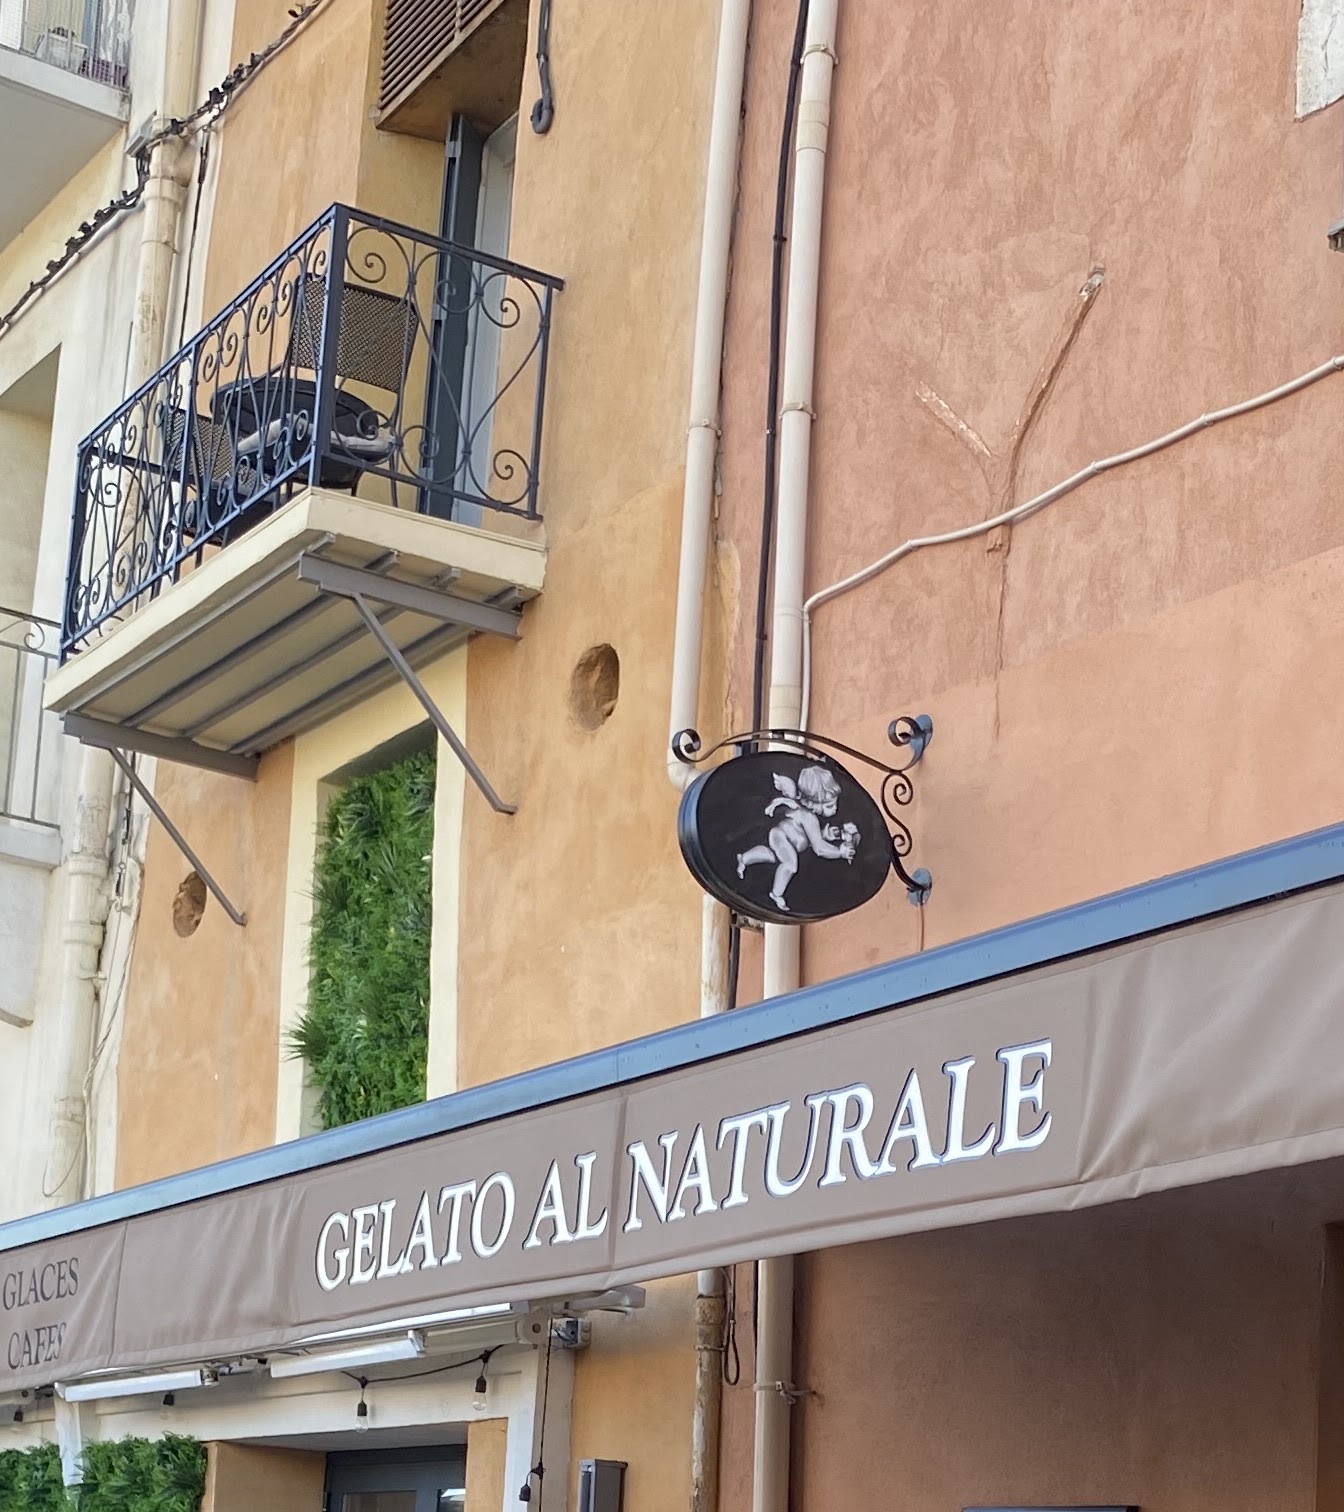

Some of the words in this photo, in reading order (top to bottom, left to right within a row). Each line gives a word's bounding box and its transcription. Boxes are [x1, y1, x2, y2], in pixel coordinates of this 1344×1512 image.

[315, 1171, 515, 1292] GELATO
[523, 1158, 608, 1251] AL
[623, 1037, 1054, 1233] NATURALE
[2, 1257, 79, 1311] GLACES
[7, 1321, 67, 1370] CAFES
